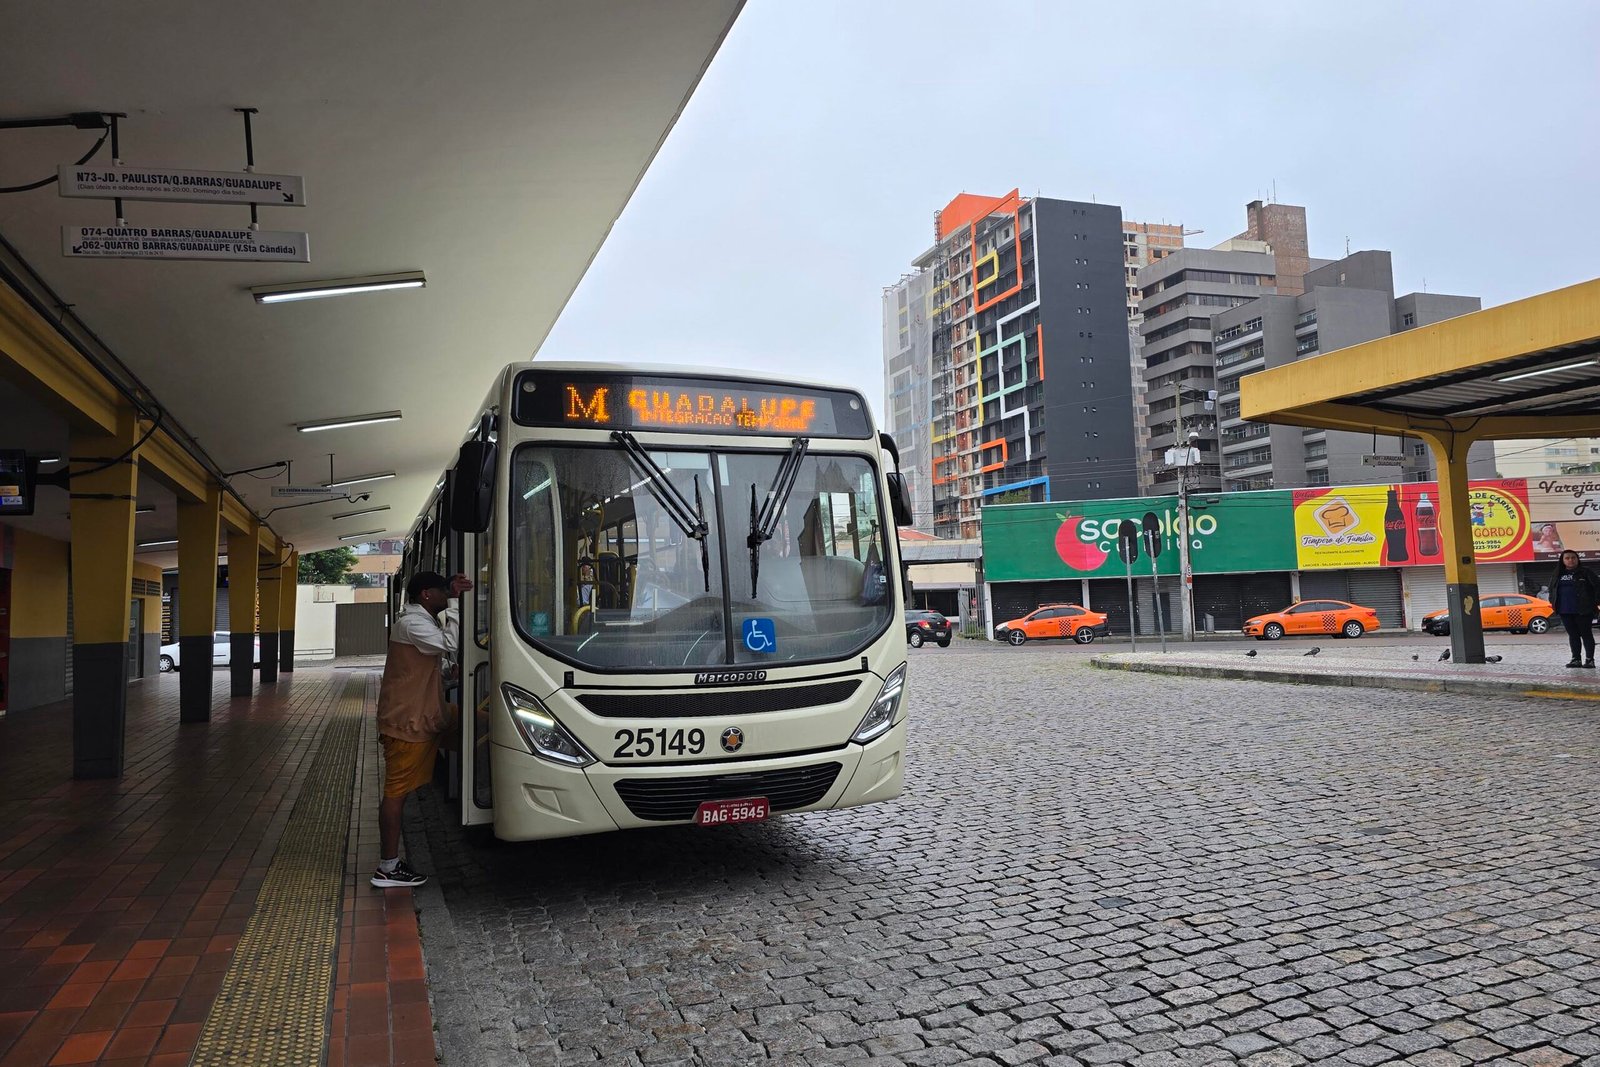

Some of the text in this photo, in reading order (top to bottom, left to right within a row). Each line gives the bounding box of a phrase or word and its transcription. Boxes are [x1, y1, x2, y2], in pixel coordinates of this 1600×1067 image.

[77, 172, 282, 191] N73-JD. PAULISTA/Q.BARRAS/GUADALUPE
[151, 228, 252, 240] BARRAS/GUADALUPE
[142, 242, 230, 252] BARRAS/GUADALUPE
[233, 244, 257, 254] (V.Sta
[259, 245, 296, 255] Cândida)
[567, 384, 816, 422] M GUADALUPE
[1490, 494, 1516, 520] CARNES
[1574, 499, 1600, 516] Fr
[1474, 527, 1513, 538] GORDO
[1303, 537, 1334, 546] Tempero
[1335, 535, 1345, 544] de
[697, 671, 766, 684] Marcopolo
[613, 728, 706, 758] 25149
